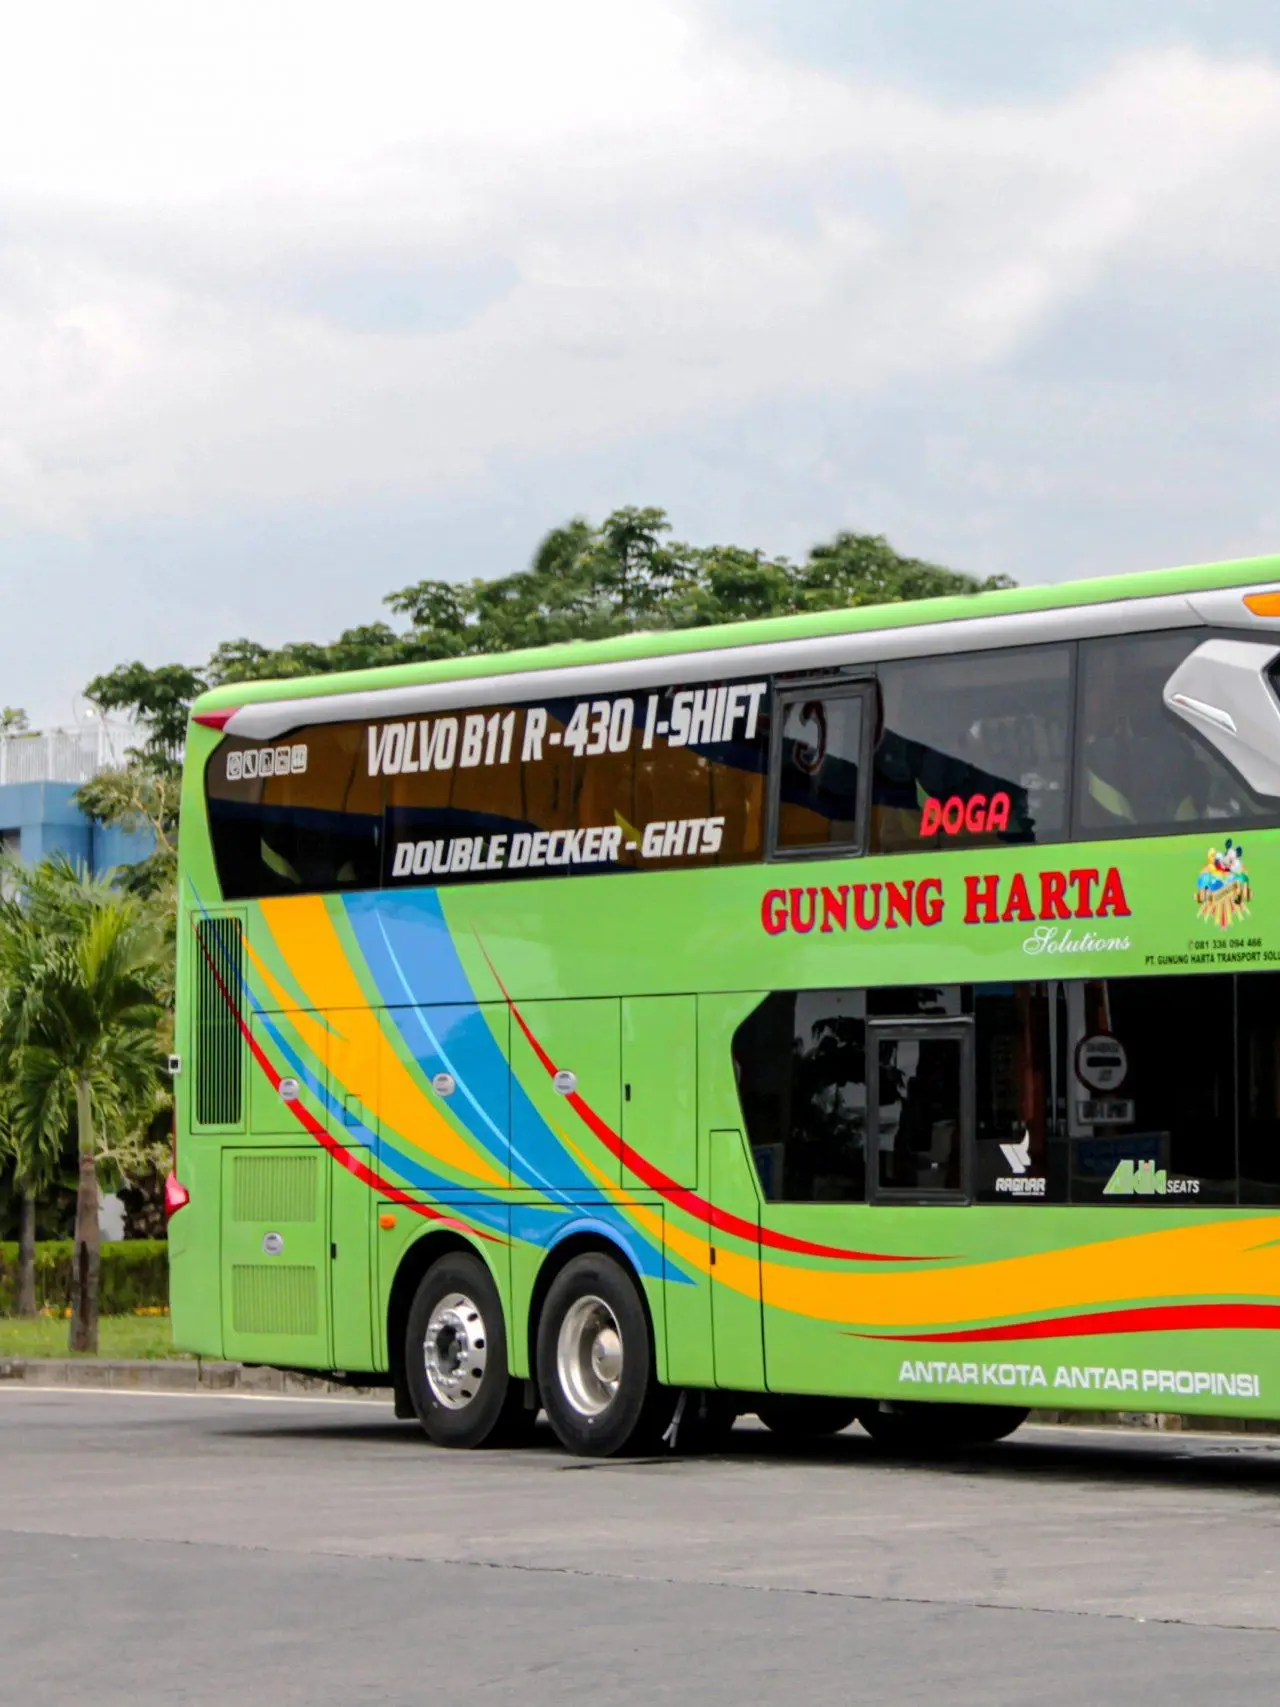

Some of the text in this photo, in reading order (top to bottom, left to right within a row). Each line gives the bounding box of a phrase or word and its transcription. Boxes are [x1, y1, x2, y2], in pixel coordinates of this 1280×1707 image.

[368, 717, 459, 776] VOLVO
[459, 711, 516, 767] B11
[642, 682, 767, 749] I-SHIFT
[919, 791, 1011, 837] DOGA
[392, 834, 506, 877] DOUBLE
[761, 867, 1131, 935] GUNUNG HARTA
[1023, 926, 1131, 955] Solutions
[1157, 954, 1188, 965] GUNUNG
[1190, 953, 1215, 963] HARTA
[1217, 951, 1260, 962] TRANSPORT
[995, 1177, 1046, 1192] RAGNAR
[1166, 1180, 1200, 1194] SEATS
[899, 1361, 1260, 1397] ANTAR KOTA ANTAR PROPINSI
